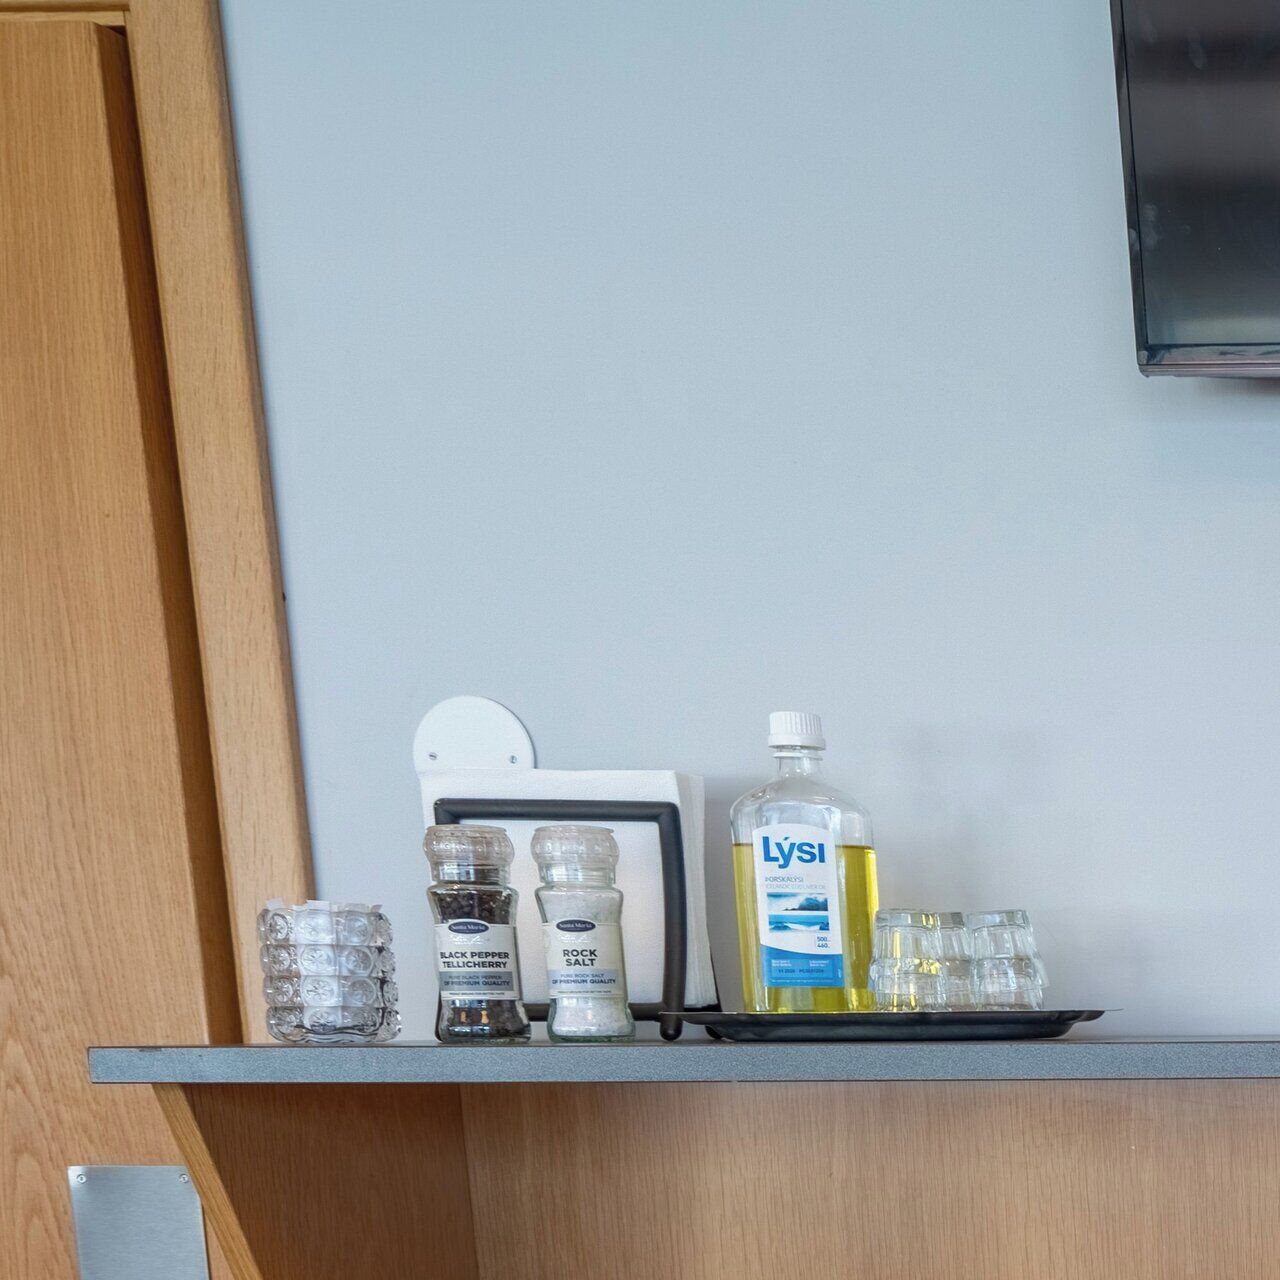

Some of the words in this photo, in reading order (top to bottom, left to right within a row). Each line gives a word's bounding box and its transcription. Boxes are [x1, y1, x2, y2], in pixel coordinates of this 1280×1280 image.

[440, 951, 467, 959] BLACK
[471, 951, 510, 959] PEPPER
[563, 949, 598, 957] ROCK
[565, 958, 597, 966] SALT
